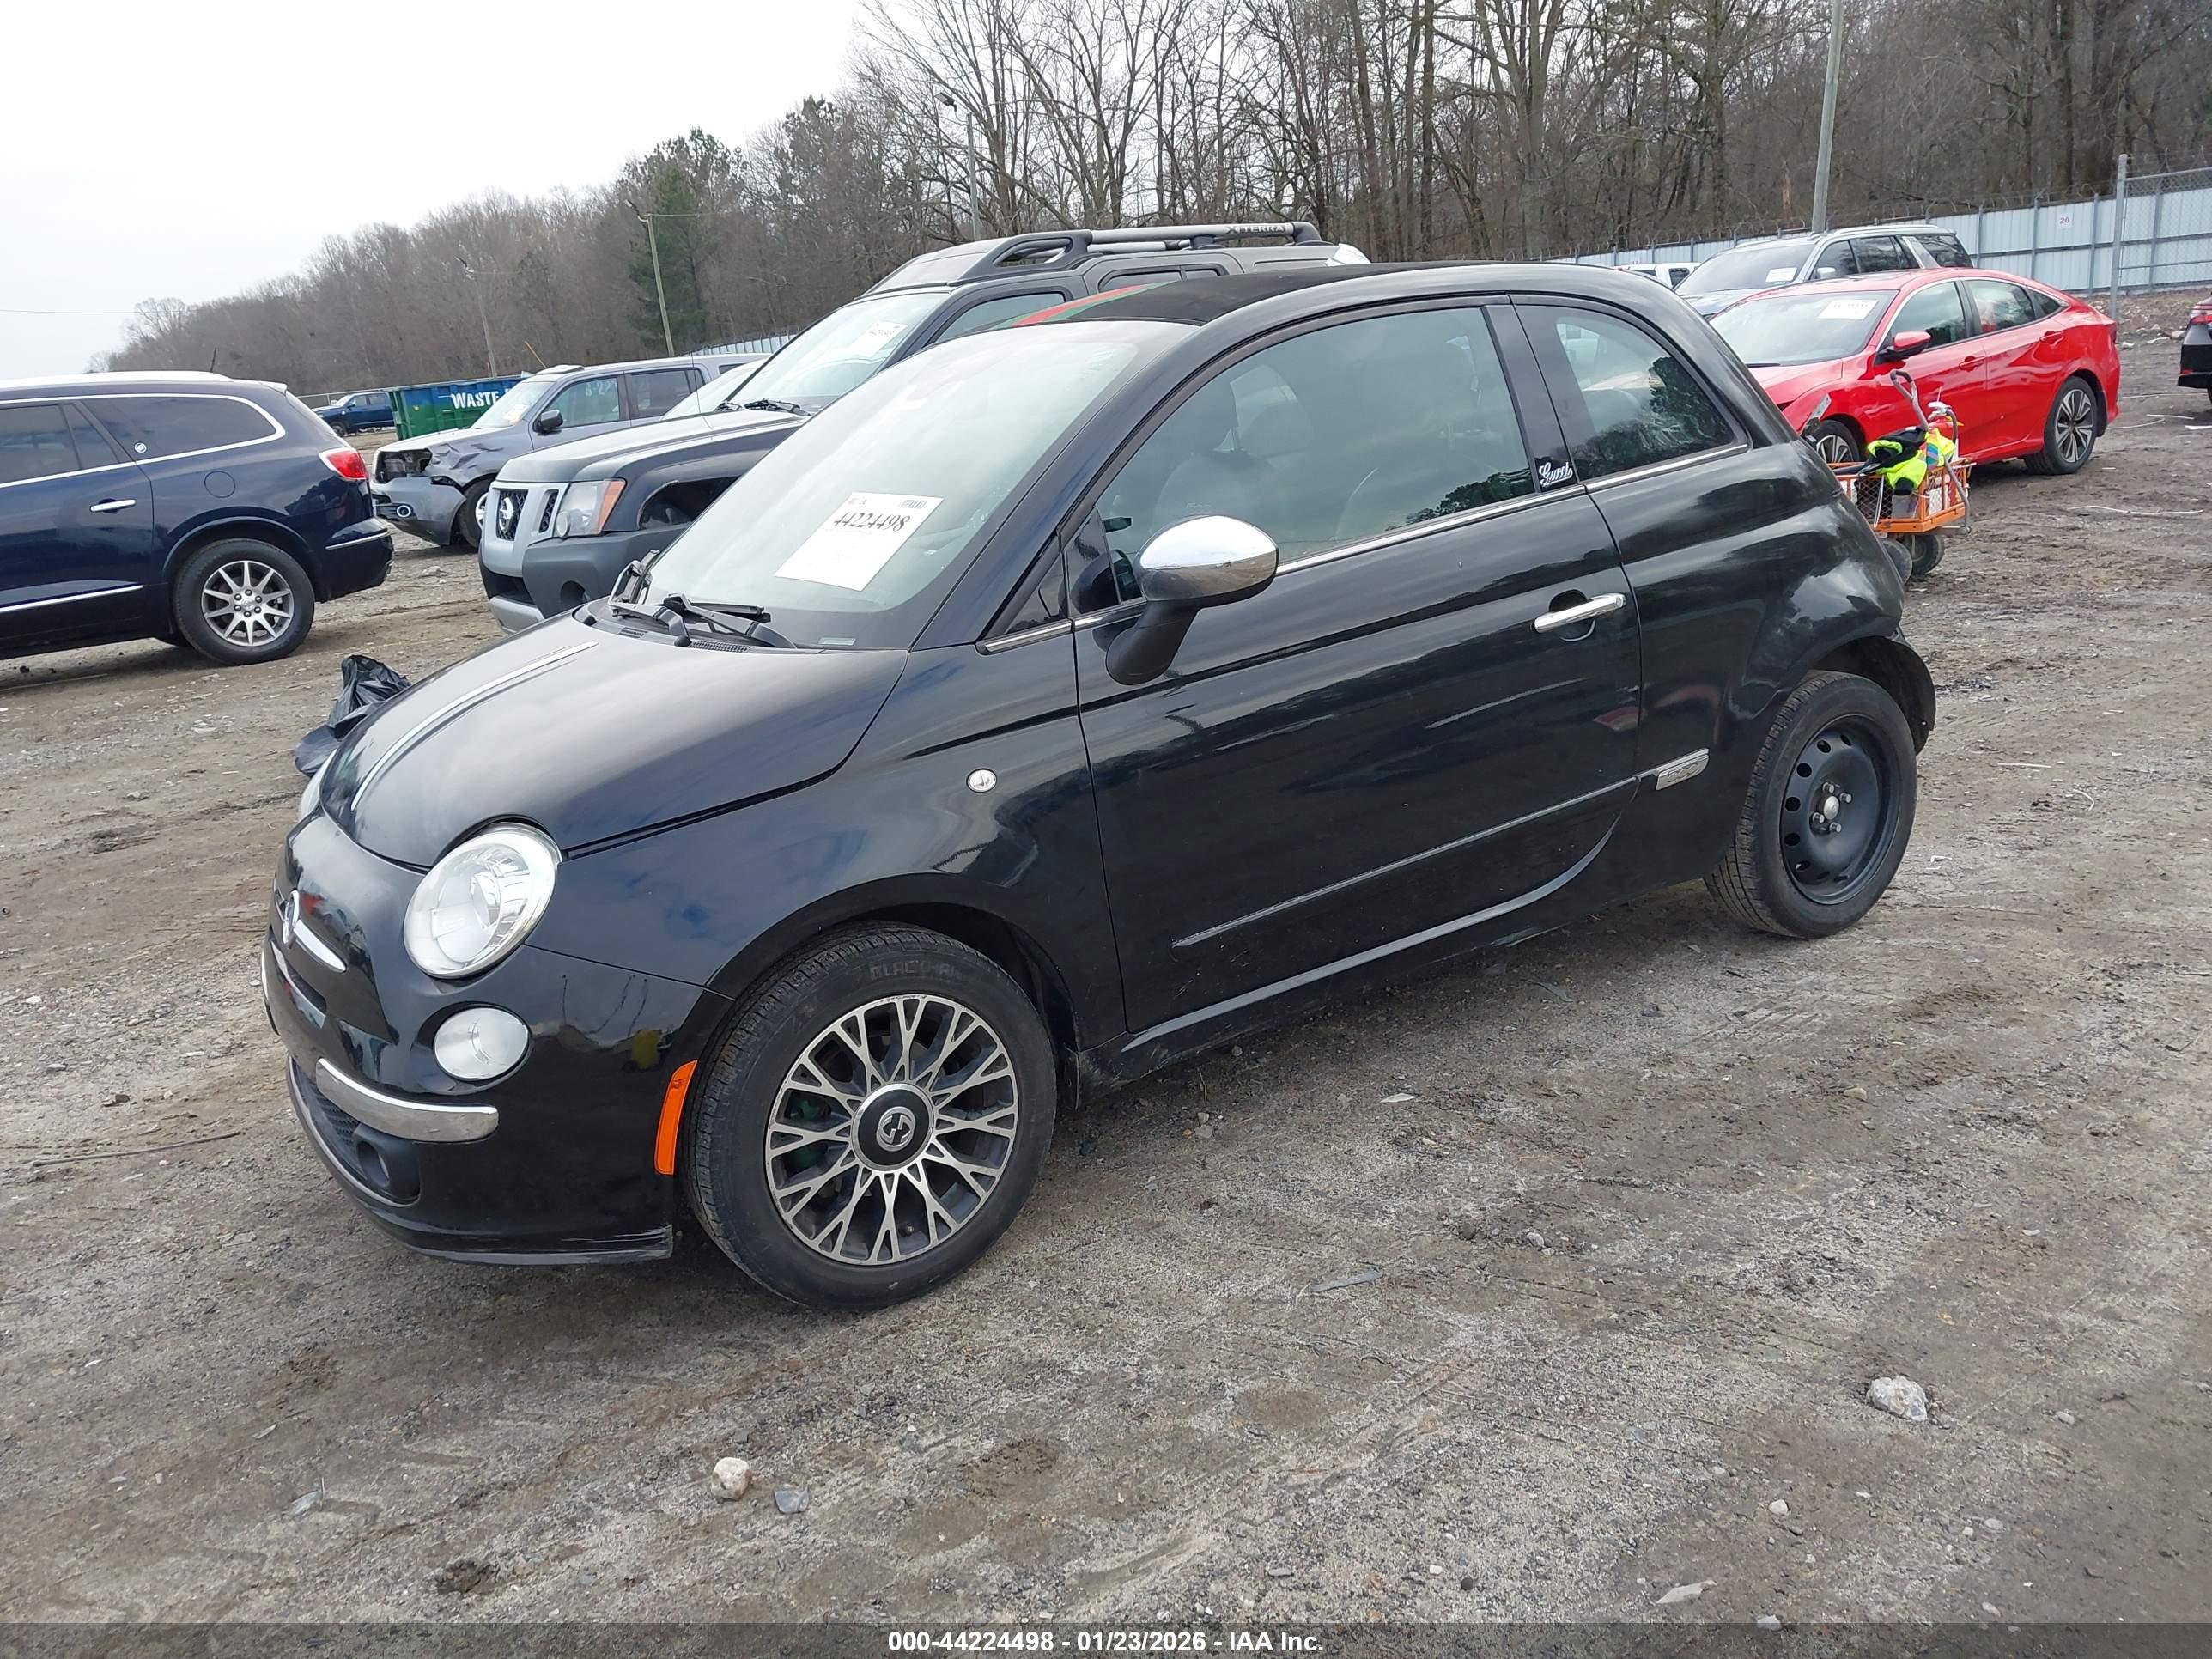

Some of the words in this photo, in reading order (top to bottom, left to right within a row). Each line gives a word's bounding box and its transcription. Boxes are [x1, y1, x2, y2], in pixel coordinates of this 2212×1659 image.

[1225, 225, 1286, 234] XTERRA
[451, 391, 499, 409] WASTE
[834, 512, 911, 532] 44224498
